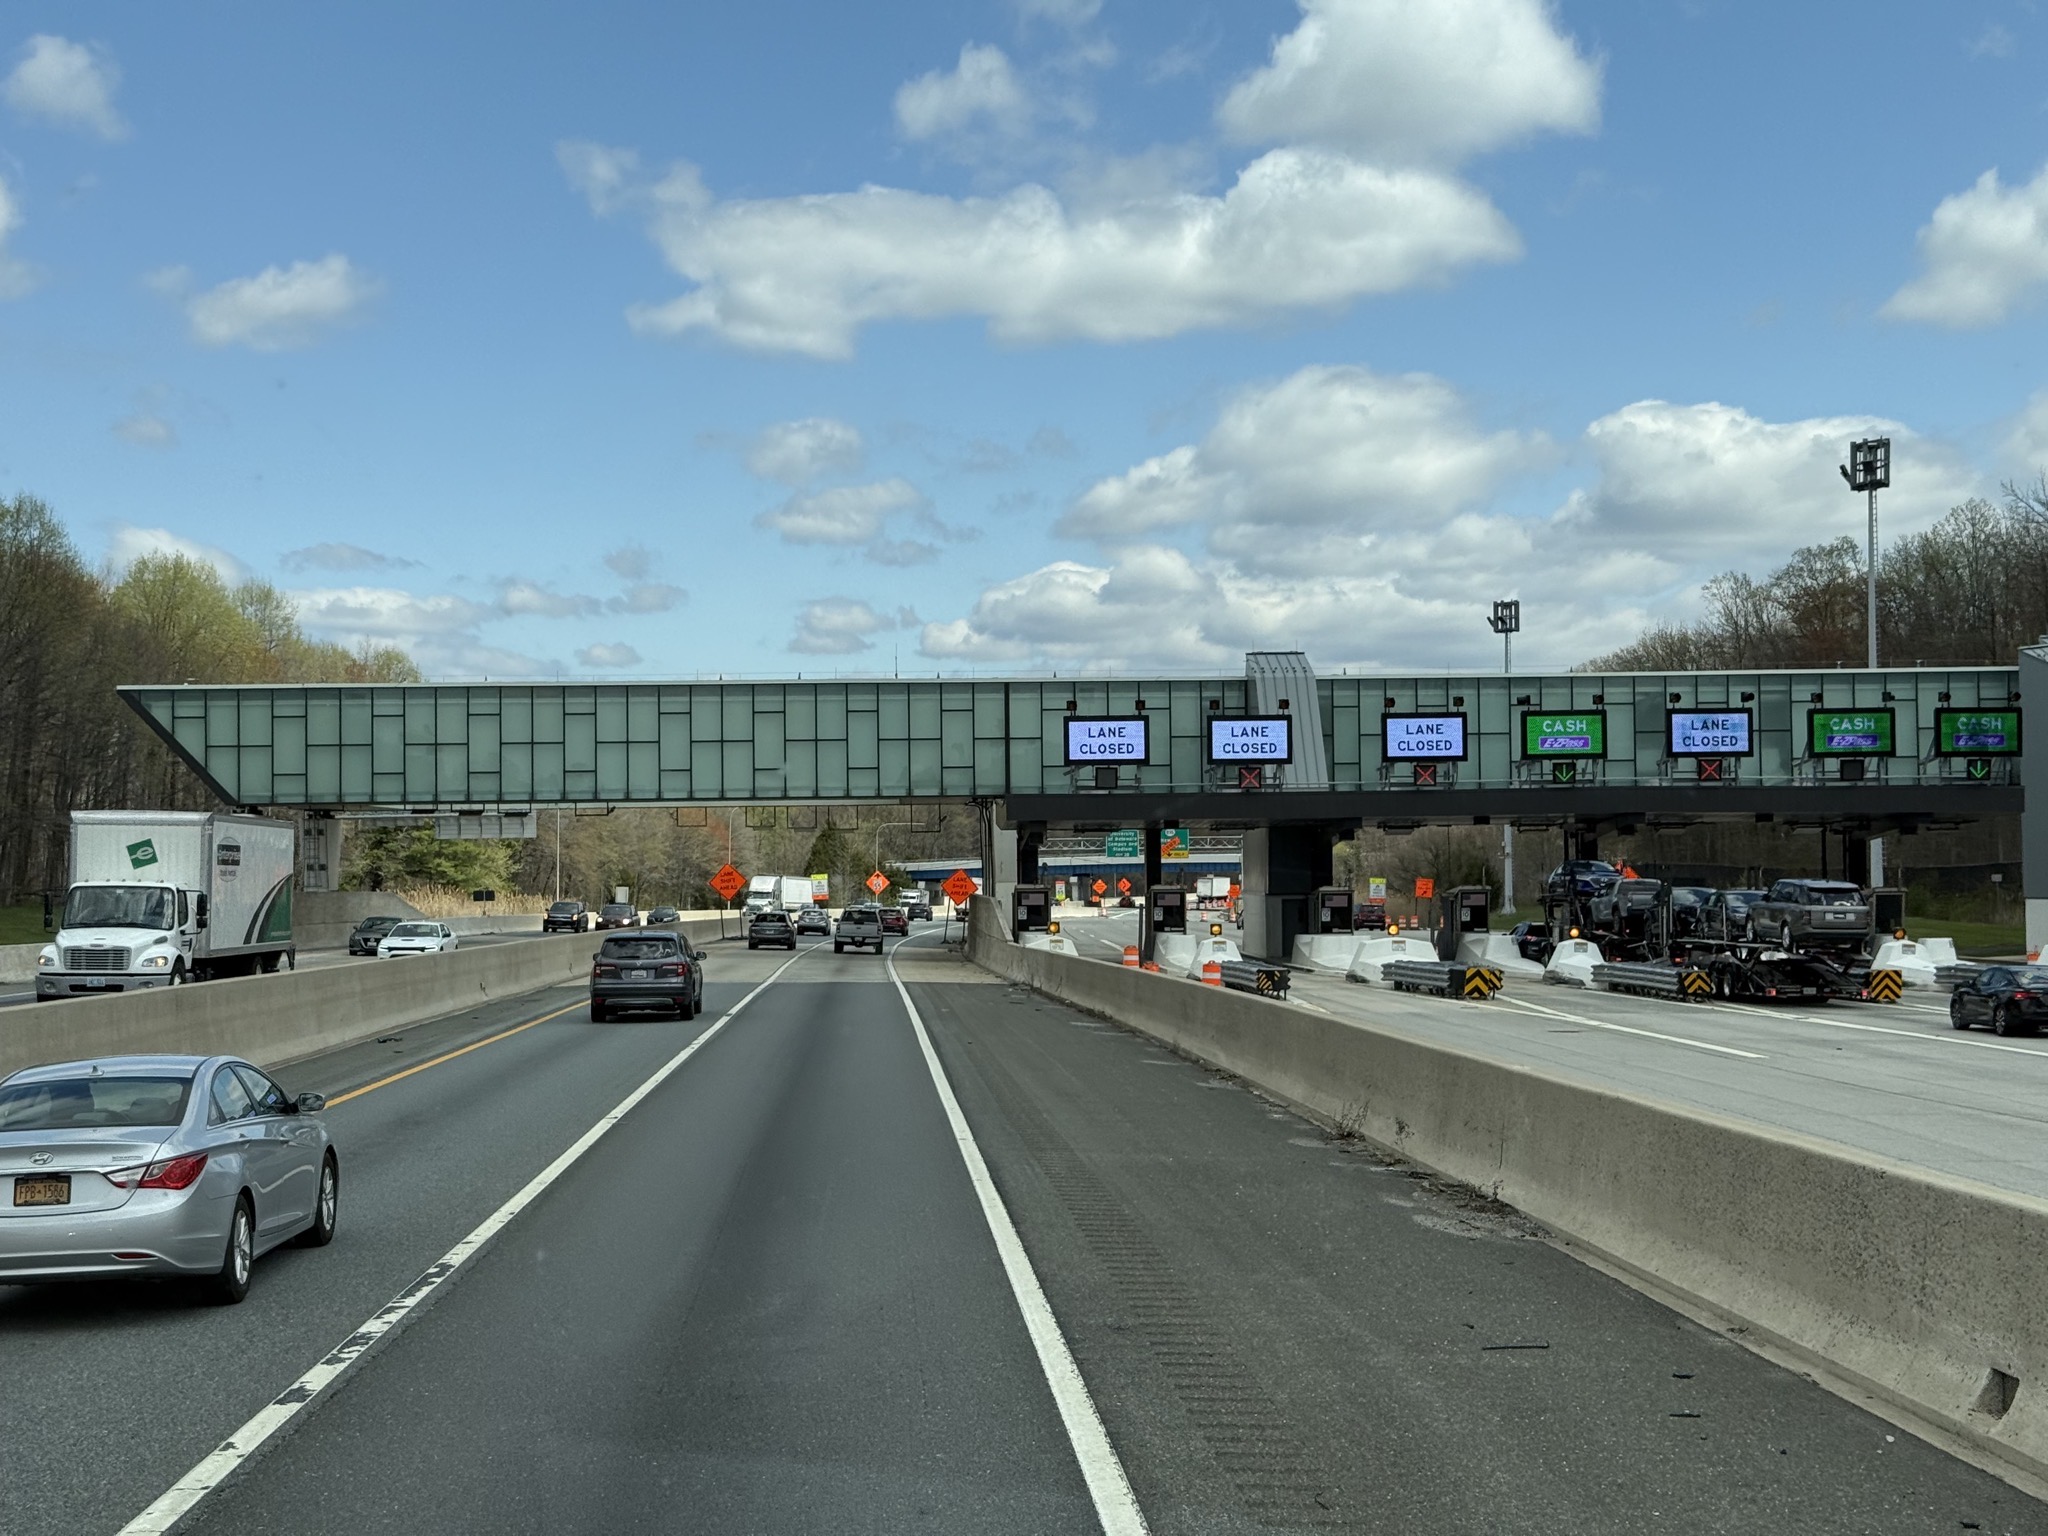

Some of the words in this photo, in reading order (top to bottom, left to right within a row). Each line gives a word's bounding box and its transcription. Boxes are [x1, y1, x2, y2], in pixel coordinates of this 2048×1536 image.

[1405, 724, 1444, 735] LANE
[1542, 720, 1587, 733] CASH
[1690, 719, 1730, 731] LANE
[1829, 717, 1875, 731] CASH
[1956, 717, 2002, 731] CASH
[1087, 726, 1127, 738] LANE
[1230, 726, 1270, 738] LANE
[1222, 742, 1278, 754] CLOSED
[1397, 740, 1453, 752] CLOSED
[1682, 736, 1739, 748] CLOSED
[1079, 743, 1136, 754] CLOSED
